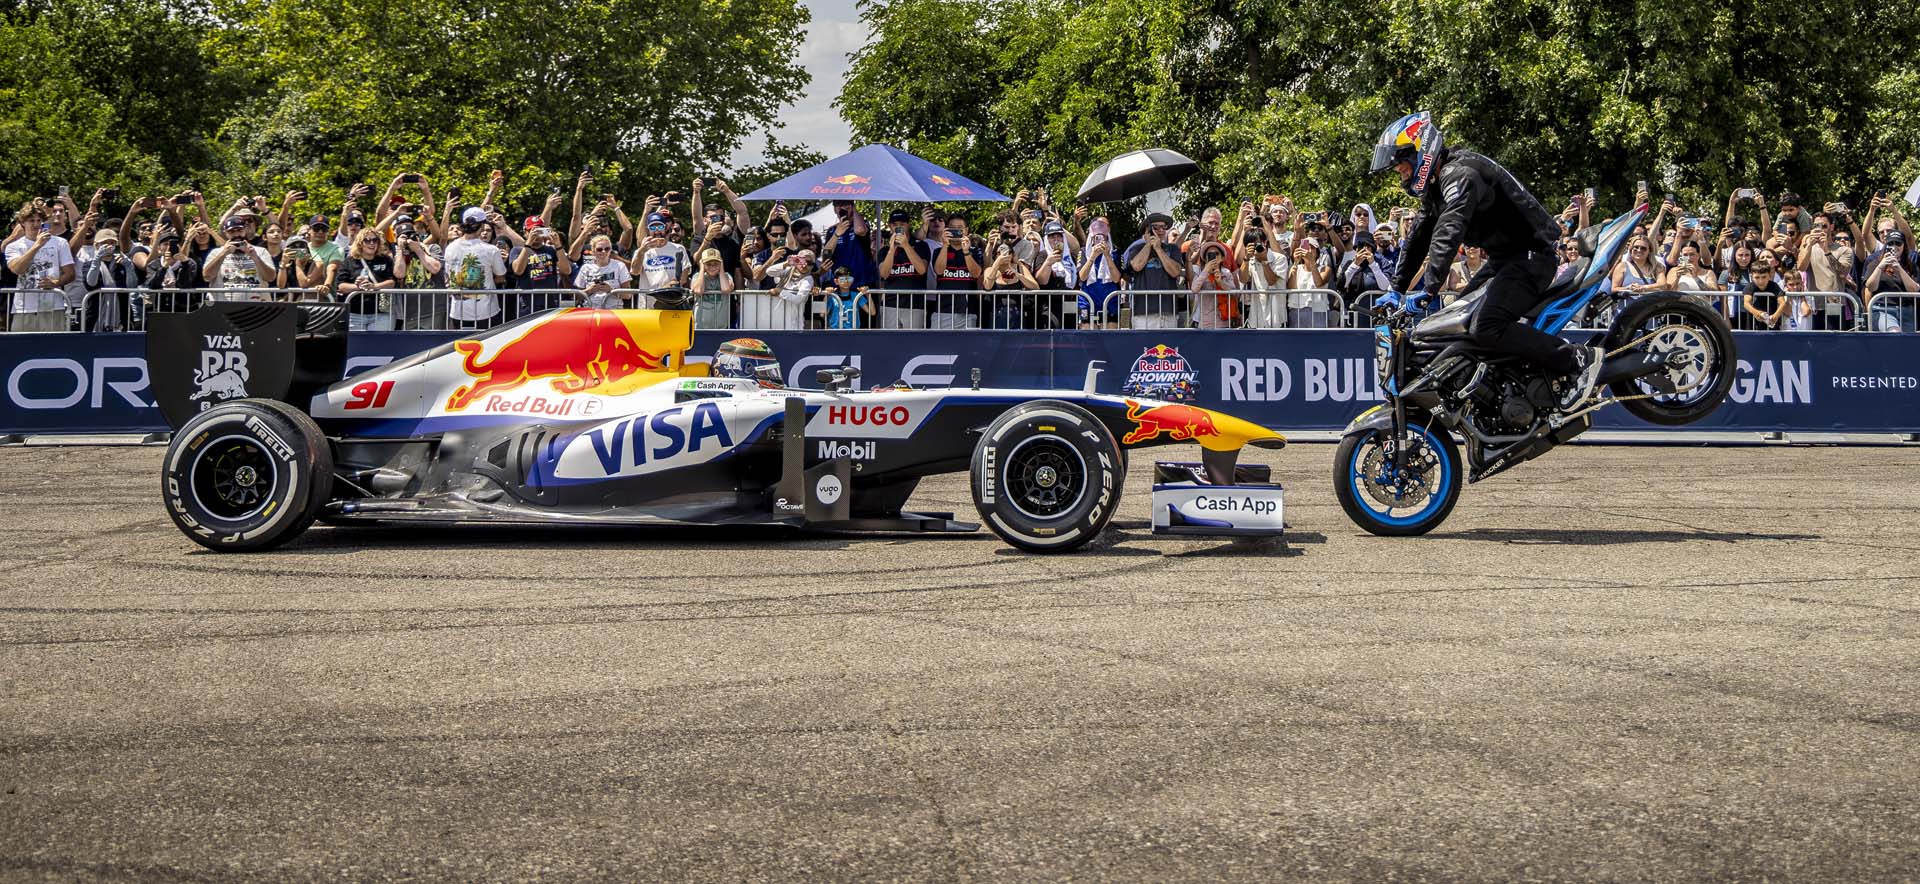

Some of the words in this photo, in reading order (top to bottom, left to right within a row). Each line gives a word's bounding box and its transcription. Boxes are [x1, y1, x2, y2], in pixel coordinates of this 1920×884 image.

[1420, 153, 1433, 172] Bull
[810, 184, 842, 194] Red
[842, 184, 872, 194] Bull
[1414, 171, 1430, 191] Red
[651, 256, 670, 266] Ford
[900, 265, 915, 274] Bull
[943, 269, 958, 278] Red
[203, 335, 242, 349] VISA
[1139, 360, 1161, 371] Red
[1162, 360, 1184, 371] Bull
[7, 357, 159, 409] OR
[696, 381, 717, 390] Cash
[718, 382, 735, 391] App
[1128, 373, 1196, 383] SHOWRUN
[1221, 358, 1292, 401] RED
[1832, 376, 1918, 389] PRESENTED
[344, 380, 396, 410] 91
[485, 394, 530, 412] Red
[529, 397, 575, 416] Bull
[828, 405, 910, 427] HUGO
[245, 416, 296, 462] PIRELLI
[582, 402, 735, 476] VISA
[818, 440, 876, 460] Mobil
[982, 446, 996, 504] PIRELLI
[1088, 451, 1113, 526] ZERO
[168, 477, 216, 538] ZERO
[1195, 495, 1238, 511] Cash
[1241, 496, 1277, 515] App
